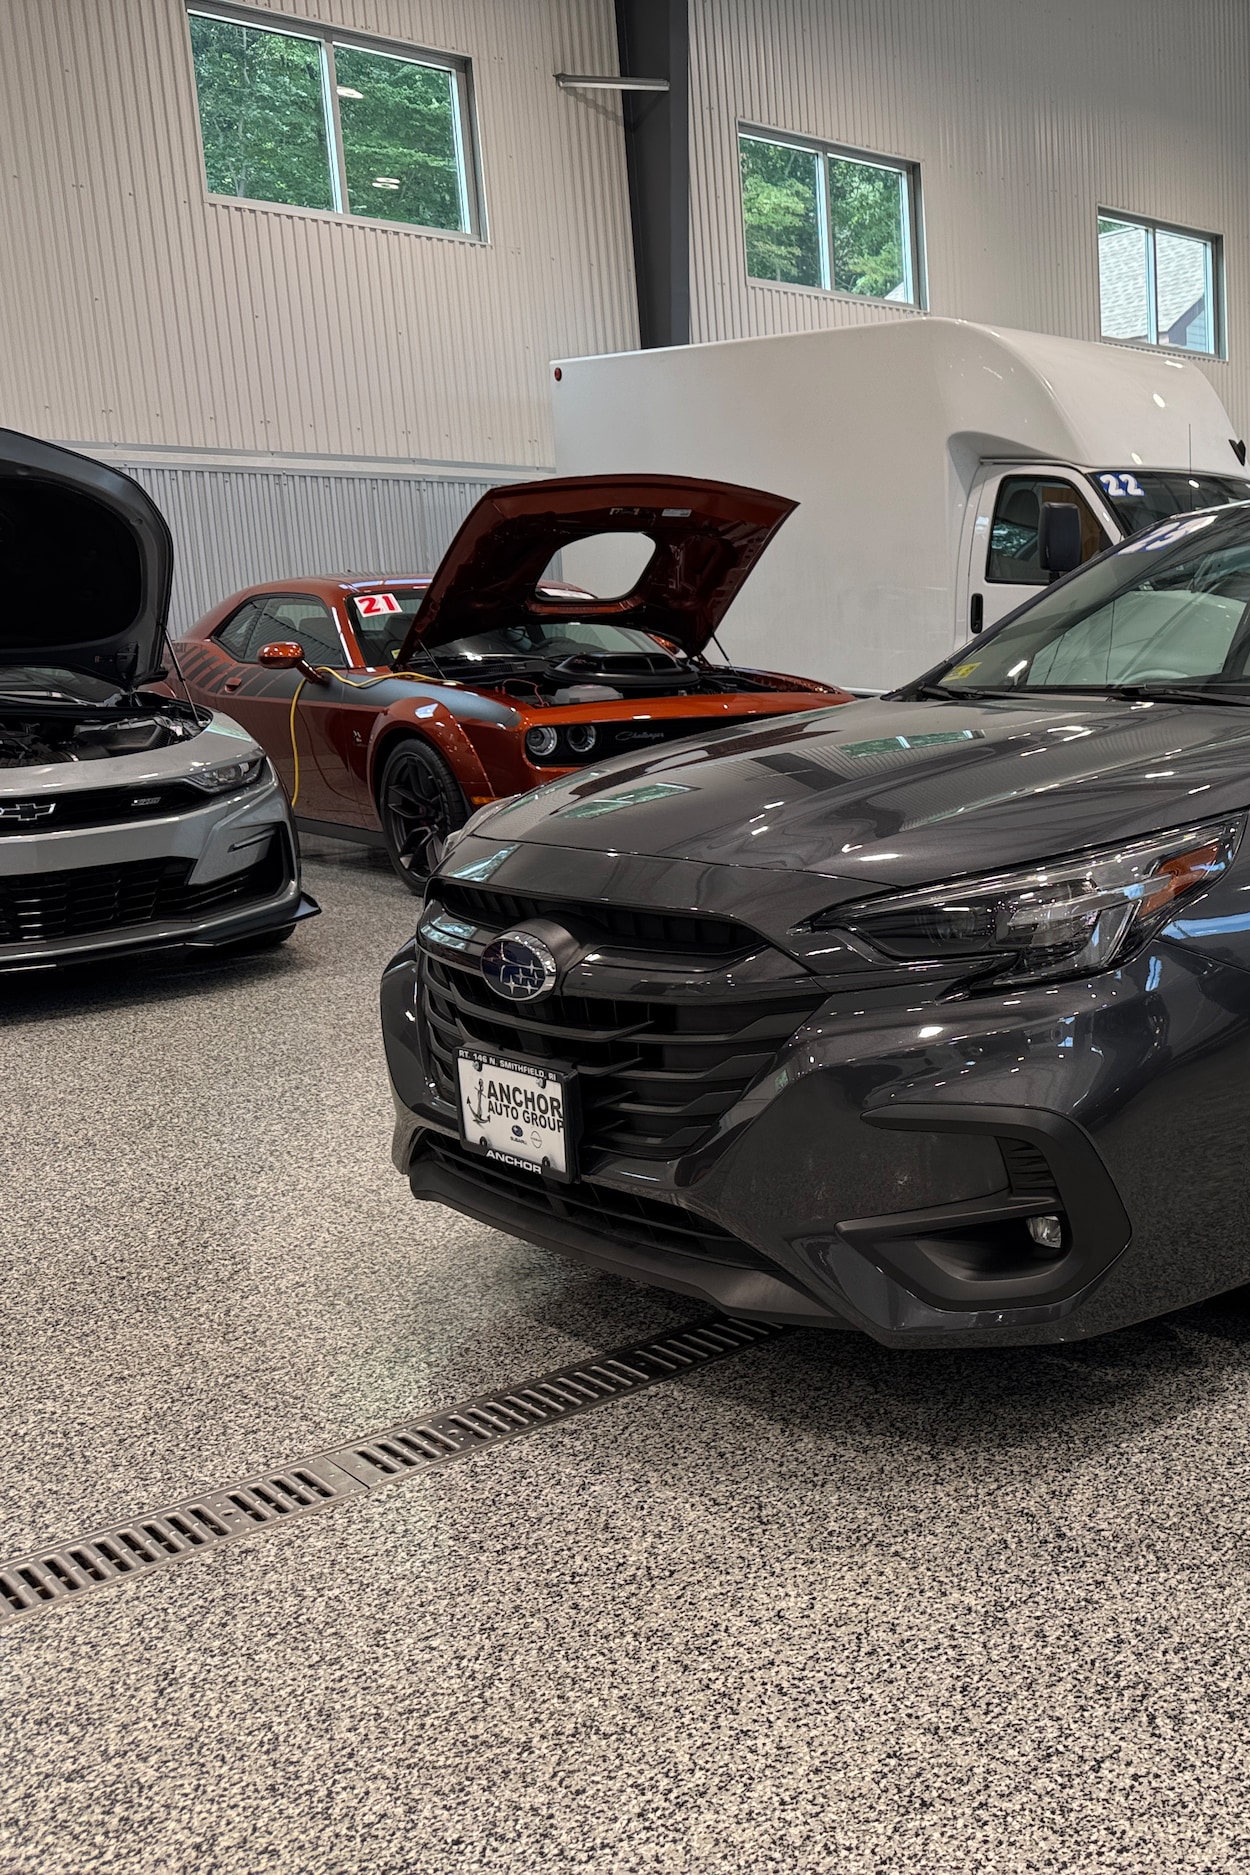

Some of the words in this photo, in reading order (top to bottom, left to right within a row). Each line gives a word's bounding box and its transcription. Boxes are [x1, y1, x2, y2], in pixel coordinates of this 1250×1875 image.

[1100, 474, 1145, 496] 22
[358, 596, 396, 614] 21
[459, 1050, 470, 1059] RT.
[473, 1053, 488, 1063] 146
[489, 1057, 498, 1066] N.
[548, 1072, 557, 1081] RI
[487, 1081, 563, 1118] ANCHOR
[487, 1101, 519, 1120] AUTO
[522, 1110, 564, 1133] GROUP
[486, 1150, 542, 1175] ANCHOR
